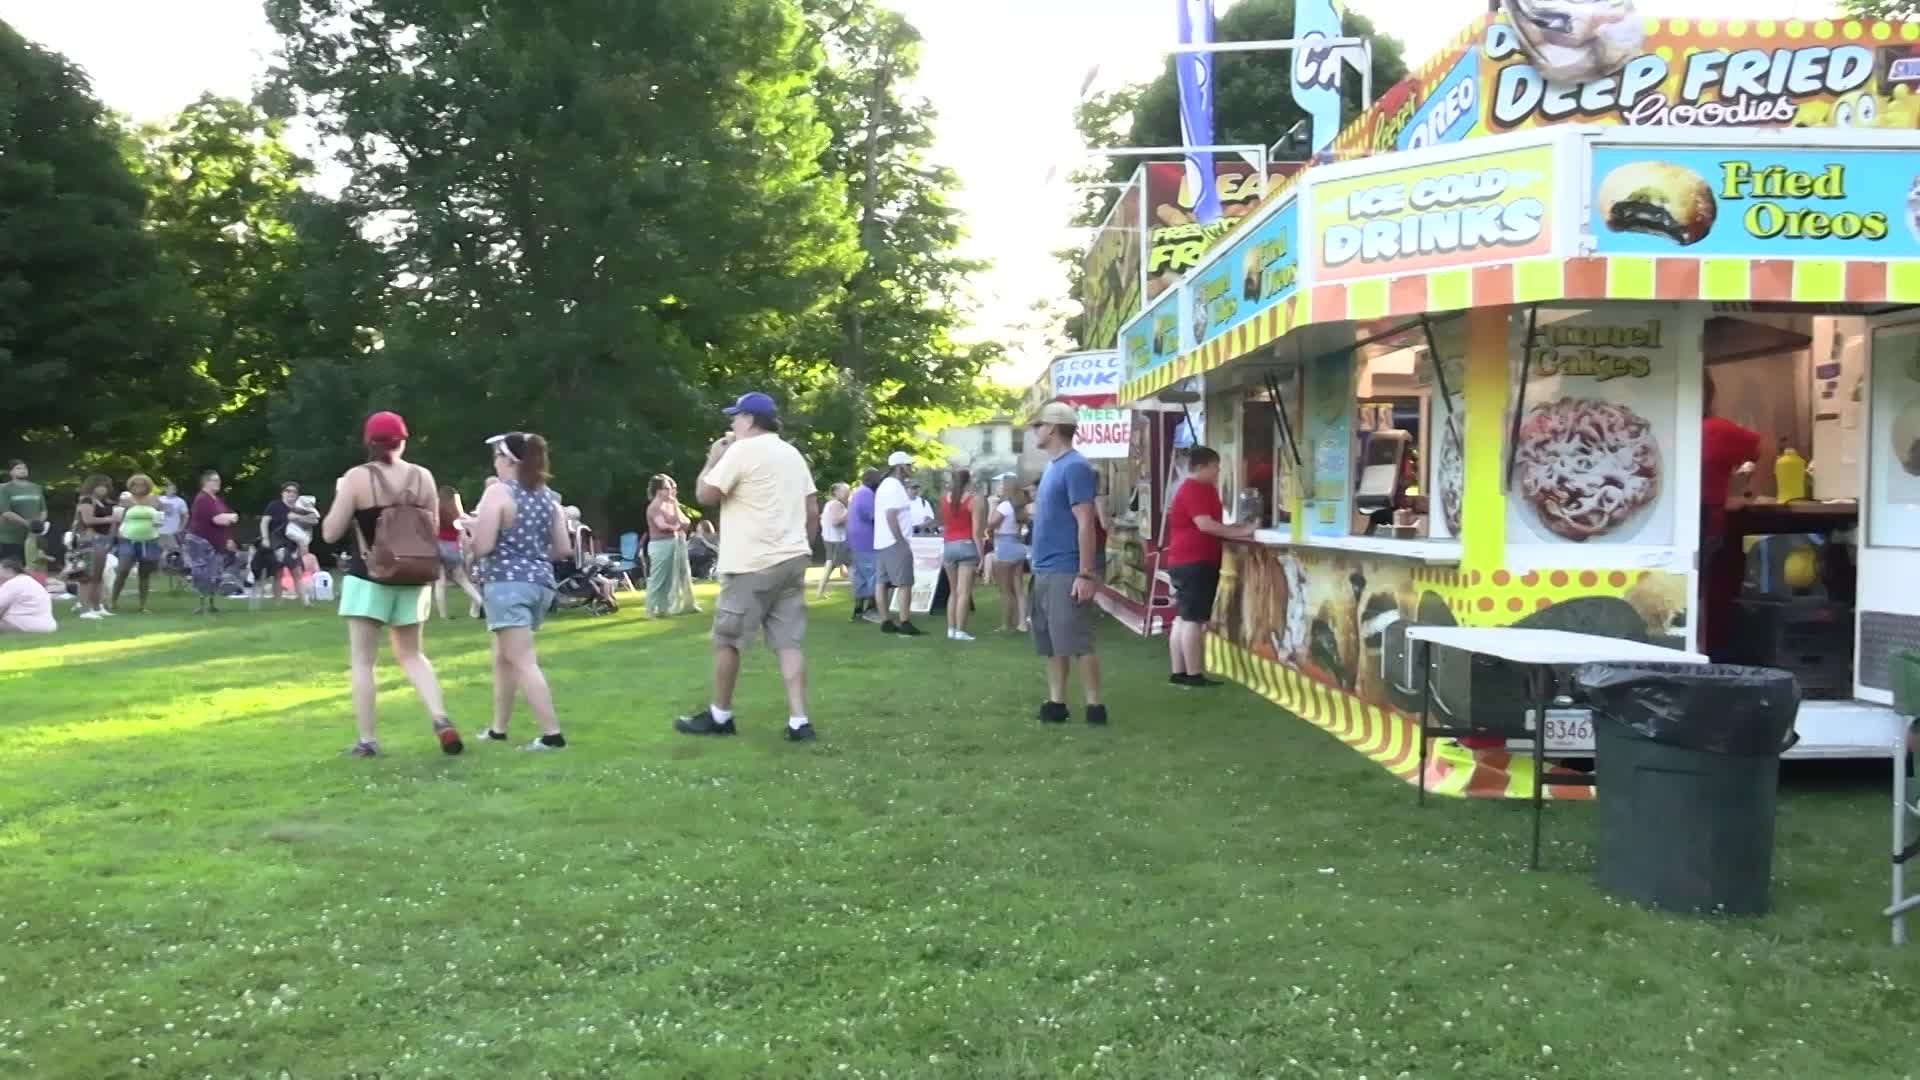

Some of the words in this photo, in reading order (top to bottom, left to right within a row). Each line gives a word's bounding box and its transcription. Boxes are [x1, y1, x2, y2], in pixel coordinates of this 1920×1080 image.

[1682, 45, 1873, 101] FRIED
[1407, 77, 1475, 150] OREO
[1624, 94, 1798, 127] Goodies
[1347, 183, 1405, 221] ICE
[1409, 168, 1510, 210] COLD
[1719, 160, 1847, 199] Fried
[1323, 197, 1545, 267] DRINKS
[1744, 201, 1889, 241] Oreos
[1534, 349, 1652, 382] Cakes
[1074, 422, 1130, 445] SAUSAGE
[1079, 408, 1125, 421] WEET
